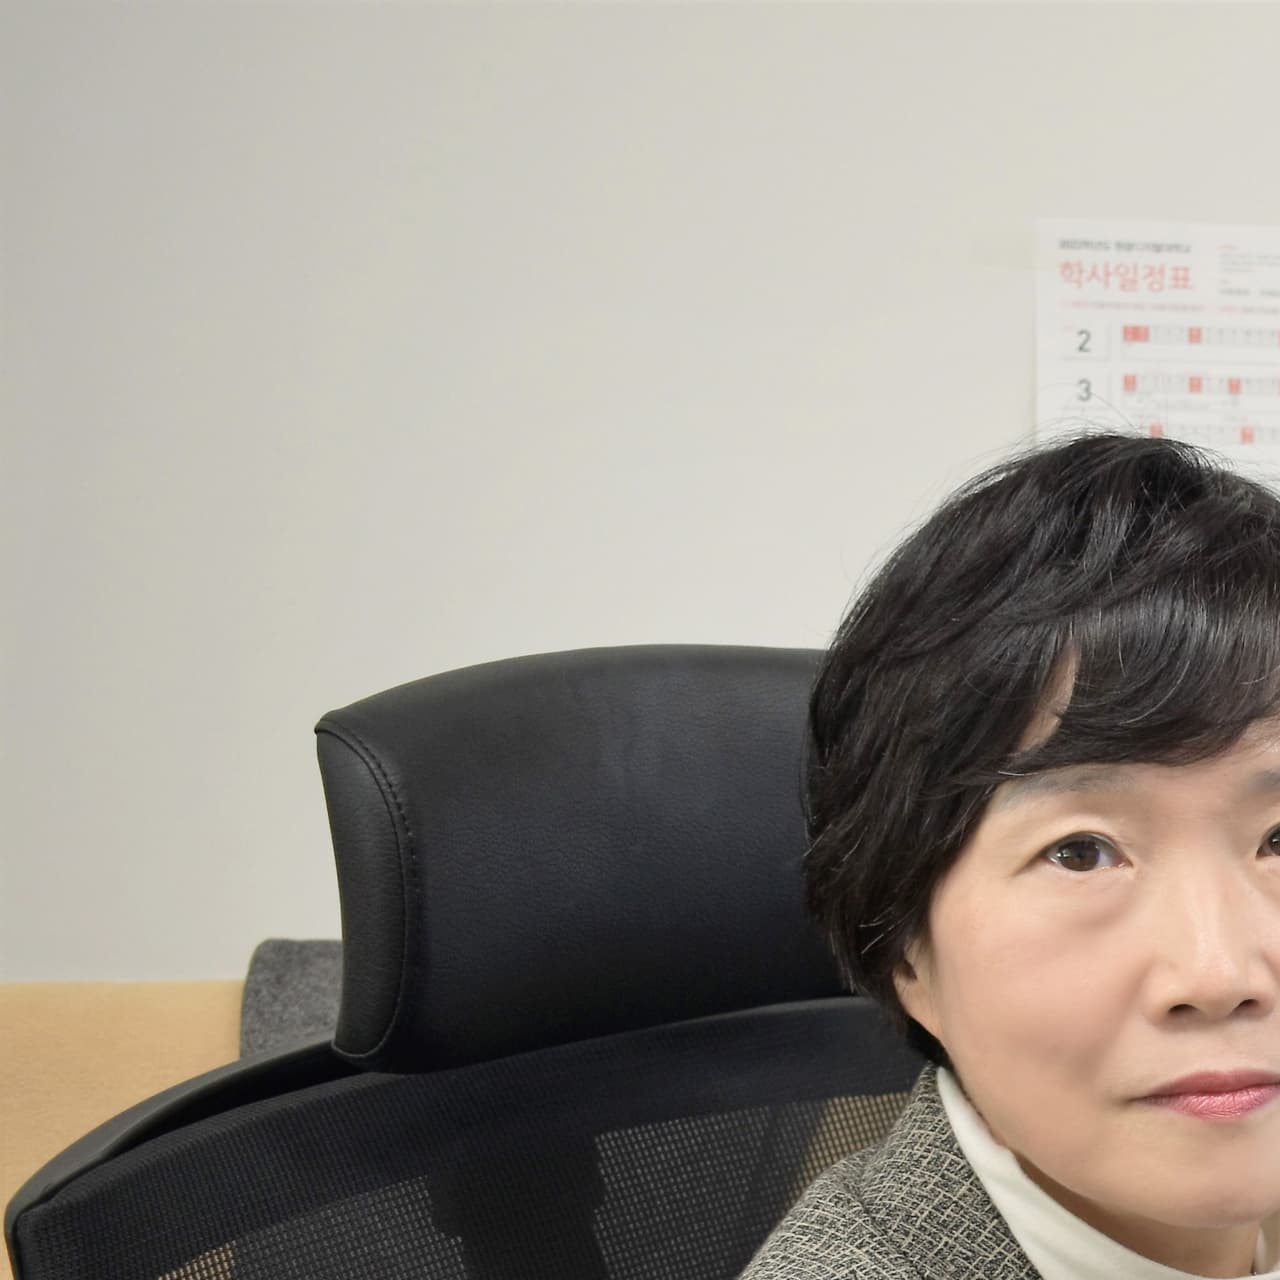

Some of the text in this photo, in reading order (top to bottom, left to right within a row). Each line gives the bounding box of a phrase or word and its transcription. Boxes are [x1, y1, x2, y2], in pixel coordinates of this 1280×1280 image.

[1058, 260, 1193, 292] 학사일정표
[1077, 330, 1091, 353] 2
[1077, 379, 1092, 402] 3
